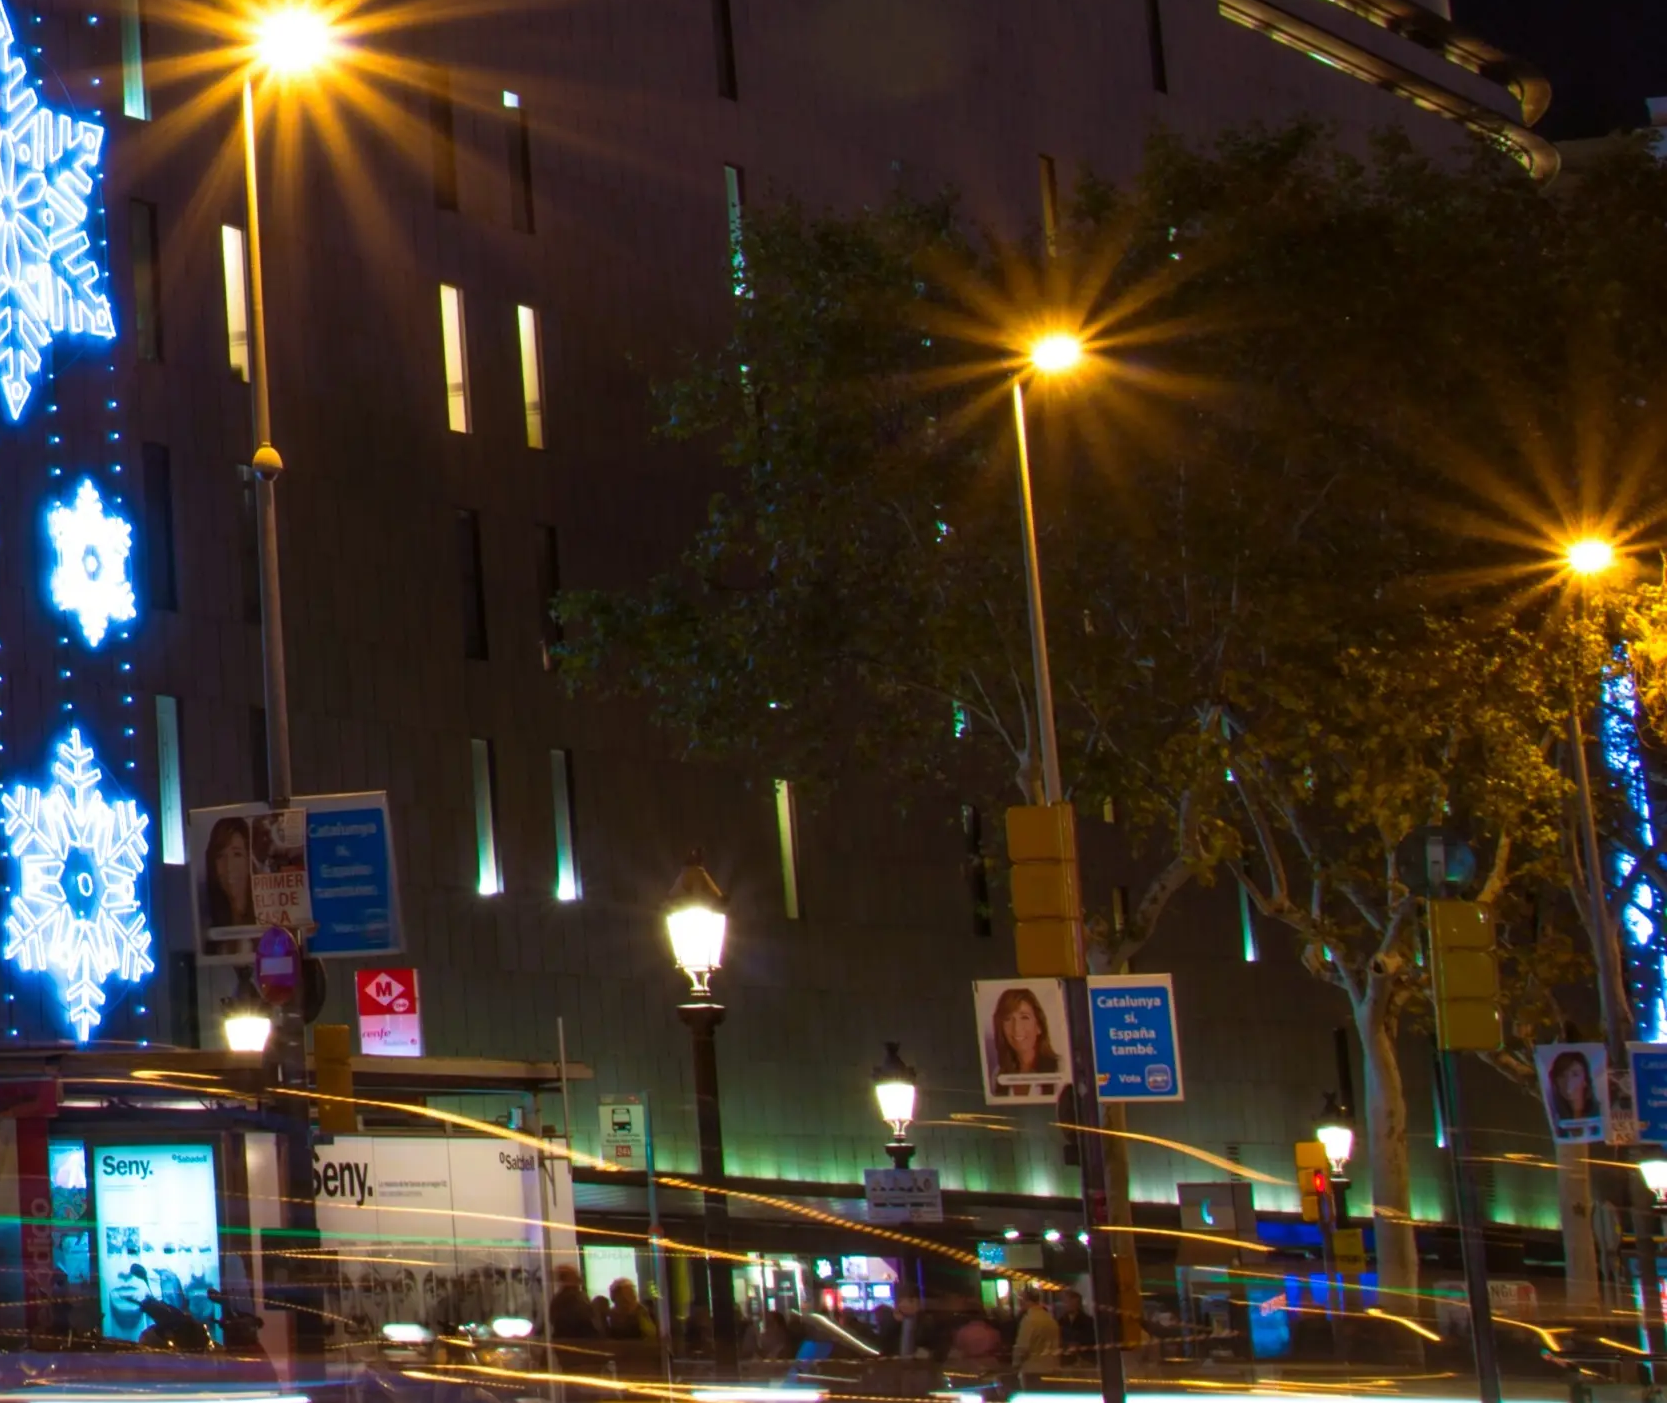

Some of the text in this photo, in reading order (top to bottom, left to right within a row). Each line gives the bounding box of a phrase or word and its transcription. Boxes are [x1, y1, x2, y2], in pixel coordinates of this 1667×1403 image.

[253, 874, 304, 891] PRIMER
[279, 892, 300, 907] DE
[1097, 996, 1161, 1010] Catalunya
[1109, 1028, 1156, 1041] España
[1111, 1043, 1158, 1056] també.
[102, 1155, 154, 1180] Seny.
